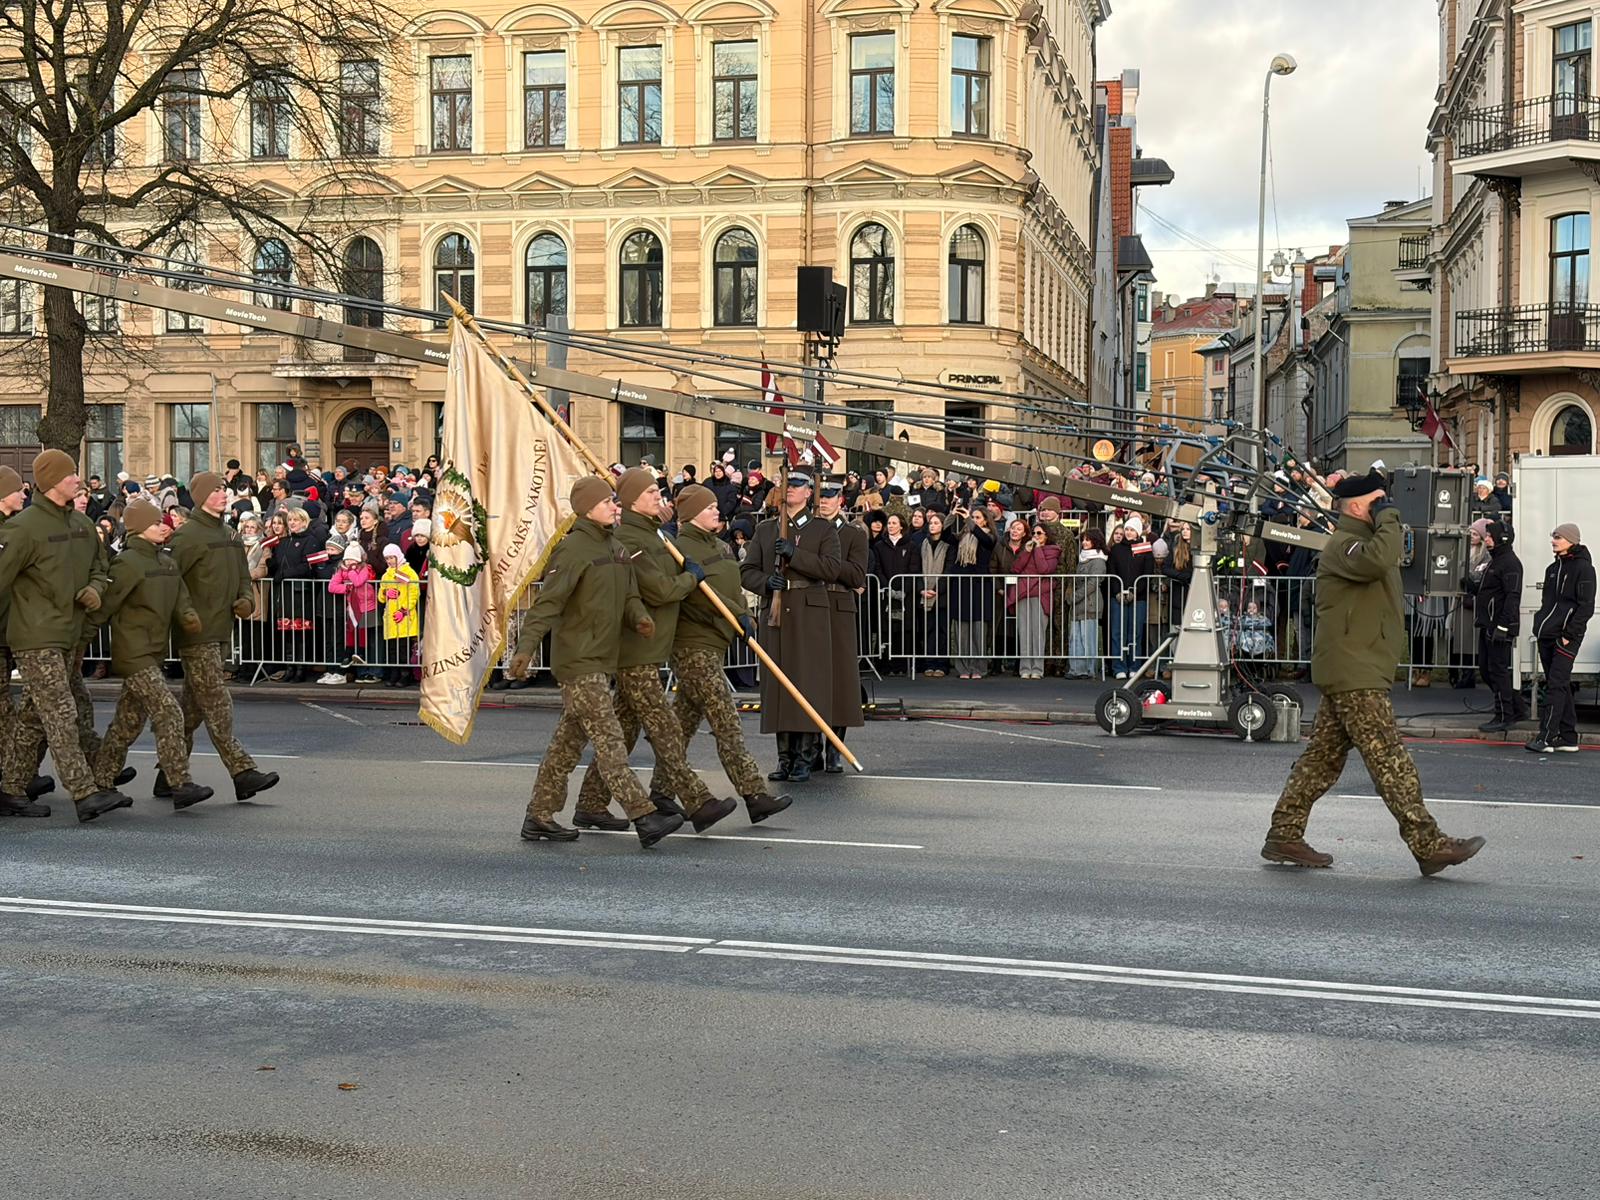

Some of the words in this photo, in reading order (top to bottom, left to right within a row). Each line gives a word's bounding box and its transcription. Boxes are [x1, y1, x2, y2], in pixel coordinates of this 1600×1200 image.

[14, 264, 58, 280] MovieTech
[225, 308, 267, 322] MovieTech
[424, 349, 450, 360] MovieT
[948, 374, 1002, 384] PRINCIPAL
[786, 423, 817, 437] MovieTec
[951, 459, 985, 472] MovieTech
[1110, 493, 1143, 506] MovieTech
[1270, 528, 1301, 541] MovieTech
[483, 603, 497, 626] UN
[1177, 709, 1212, 717] MovieTech
